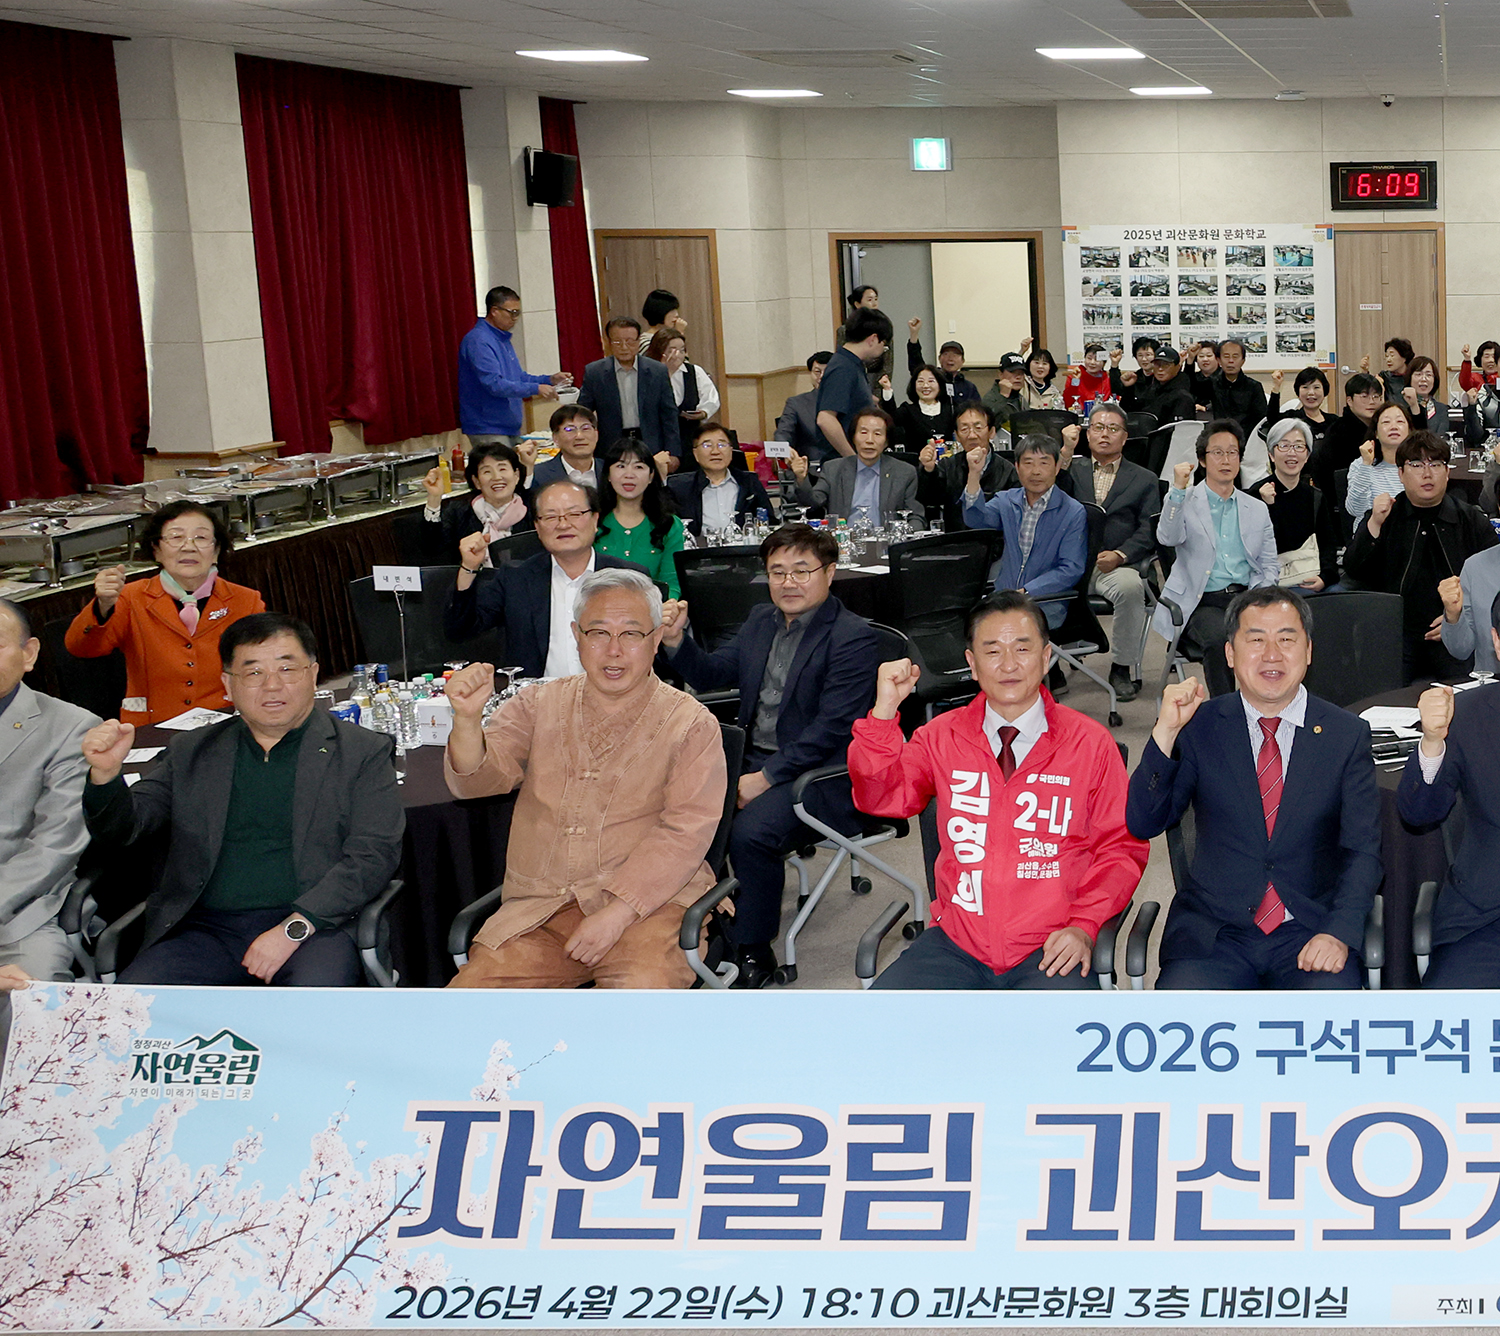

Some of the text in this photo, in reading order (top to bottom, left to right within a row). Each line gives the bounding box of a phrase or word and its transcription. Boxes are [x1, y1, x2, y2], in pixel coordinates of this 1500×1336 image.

[1356, 172, 1419, 197] 6:09
[1123, 228, 1267, 240] 2025년 괴산문화원 문화학교
[1039, 774, 1071, 787] 국민의힘
[1013, 791, 1073, 837] 2-나
[133, 1039, 172, 1050] 청정괴산
[1075, 1021, 1240, 1073] 2026
[1255, 1018, 1470, 1076] 구석구석
[130, 1051, 260, 1085] 자연울림
[129, 1087, 251, 1099] 자연이 미래가 되는 그 곳
[397, 1109, 975, 1241] 자연울림
[385, 1284, 1349, 1320] 2026년 4월 22일(수) 18:10 괴산문화원 3층 대회의실
